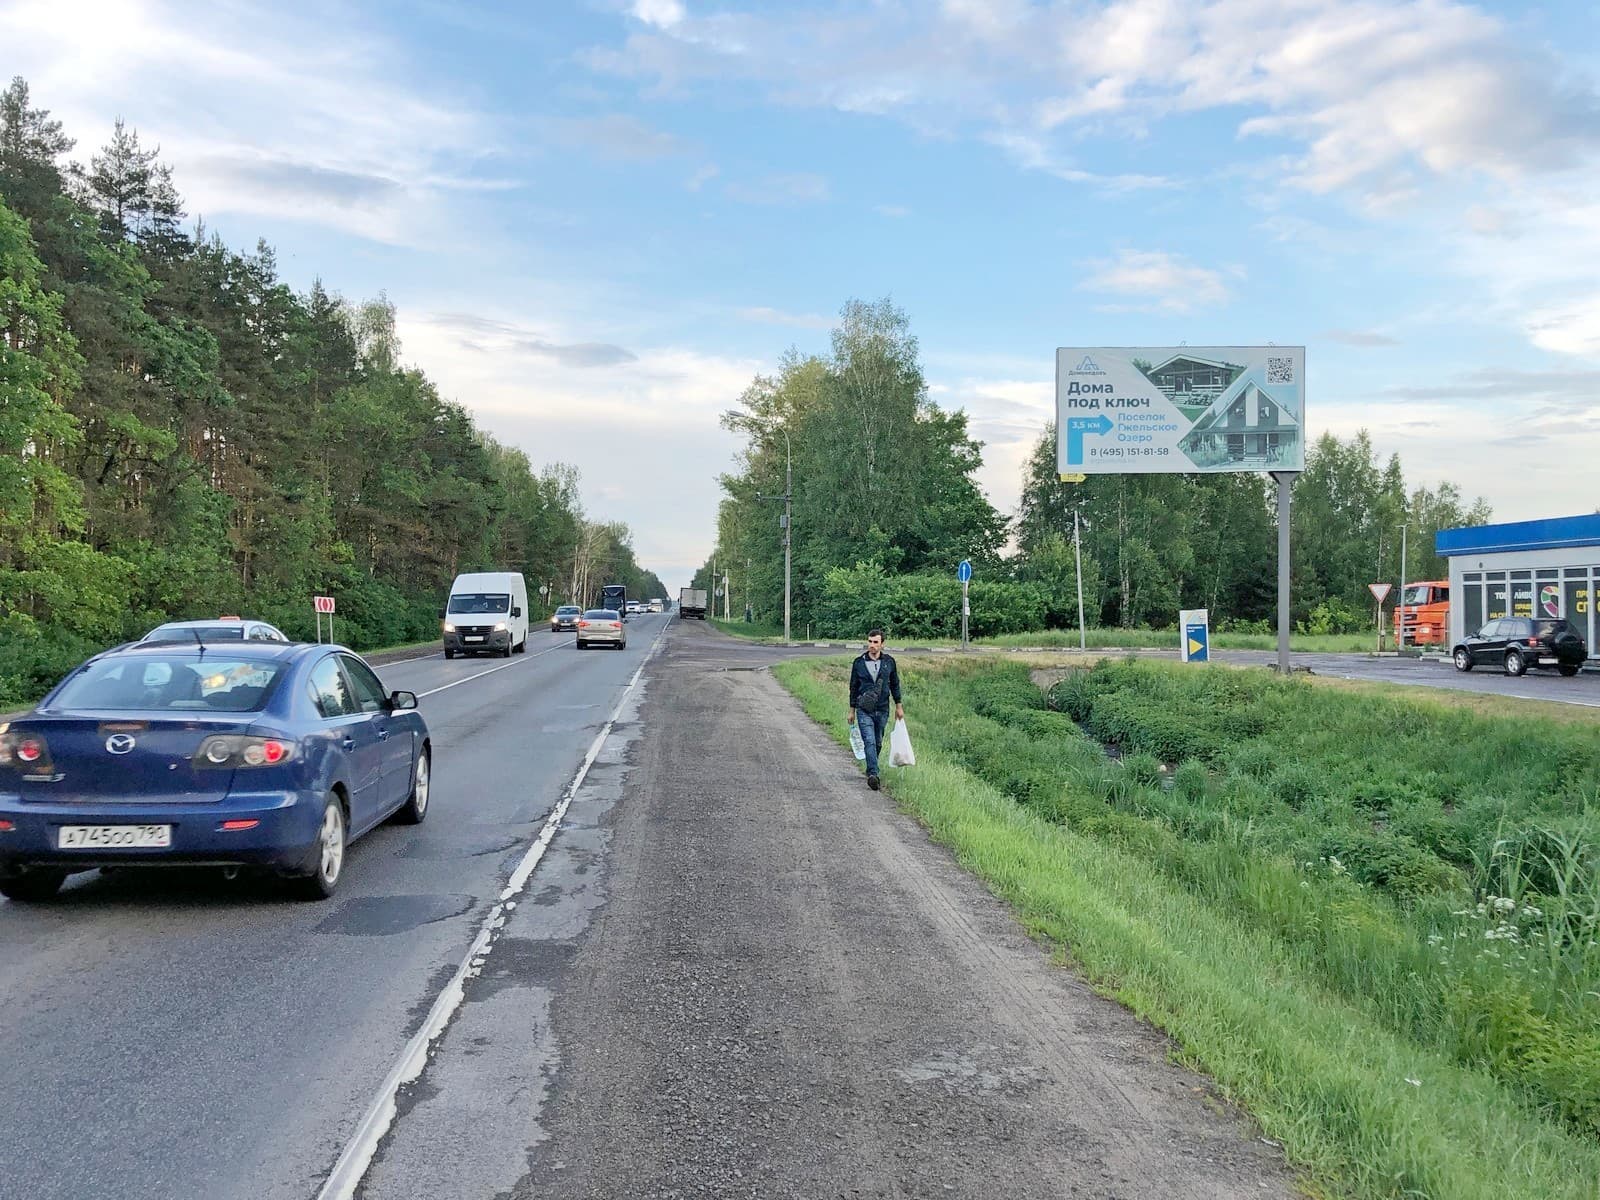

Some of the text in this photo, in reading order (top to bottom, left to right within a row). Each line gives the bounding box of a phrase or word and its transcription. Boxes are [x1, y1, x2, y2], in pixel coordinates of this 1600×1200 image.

[1067, 381, 1114, 396] Дома
[1068, 398, 1150, 410] под ключ
[1118, 413, 1165, 421] Поселок
[1071, 421, 1085, 431] 3,5
[1118, 423, 1178, 431] Гжельское
[1117, 433, 1153, 443] Озеро
[1090, 447, 1169, 457] 8 (495) 151-81-58
